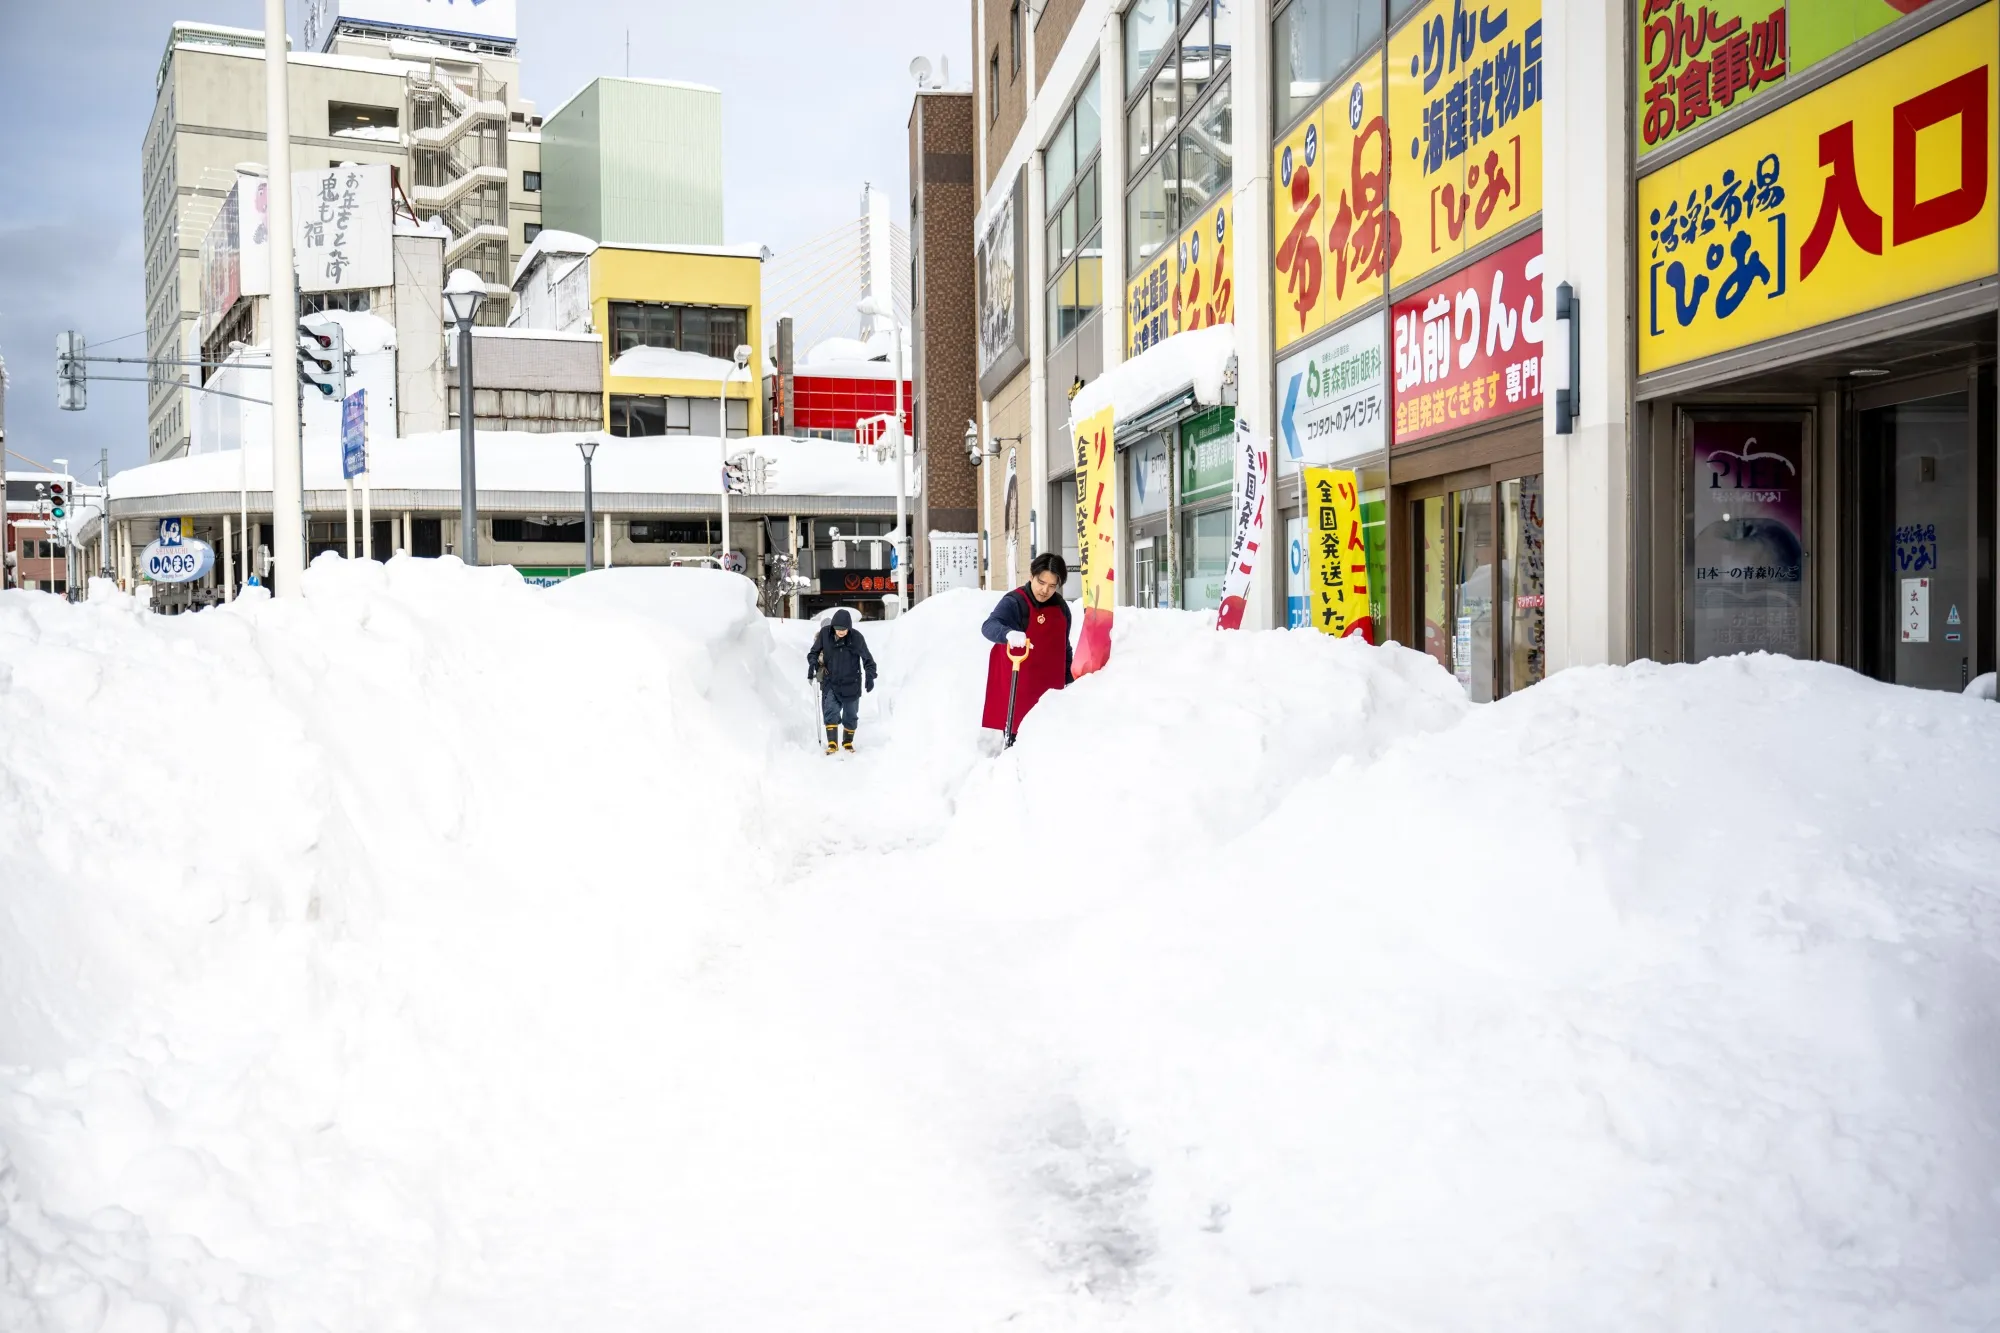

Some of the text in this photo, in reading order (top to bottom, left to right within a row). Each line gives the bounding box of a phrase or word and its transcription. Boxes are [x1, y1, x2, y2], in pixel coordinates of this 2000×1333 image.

[1643, 8, 1787, 145] お食事処
[1800, 64, 1988, 282] 入口
[1276, 115, 1402, 333] 市場
[1321, 344, 1381, 399] 青森駅前眼科
[1505, 356, 1543, 402] 専門
[1307, 395, 1381, 440] コンタクトのアイシティ
[1395, 371, 1500, 436] 全国発送できます
[150, 554, 195, 574] しんまち
[1316, 479, 1345, 638] 全国発送いた
[1697, 566, 1799, 580] 日本一の青森りんご
[1910, 590, 1919, 630] 出入口
